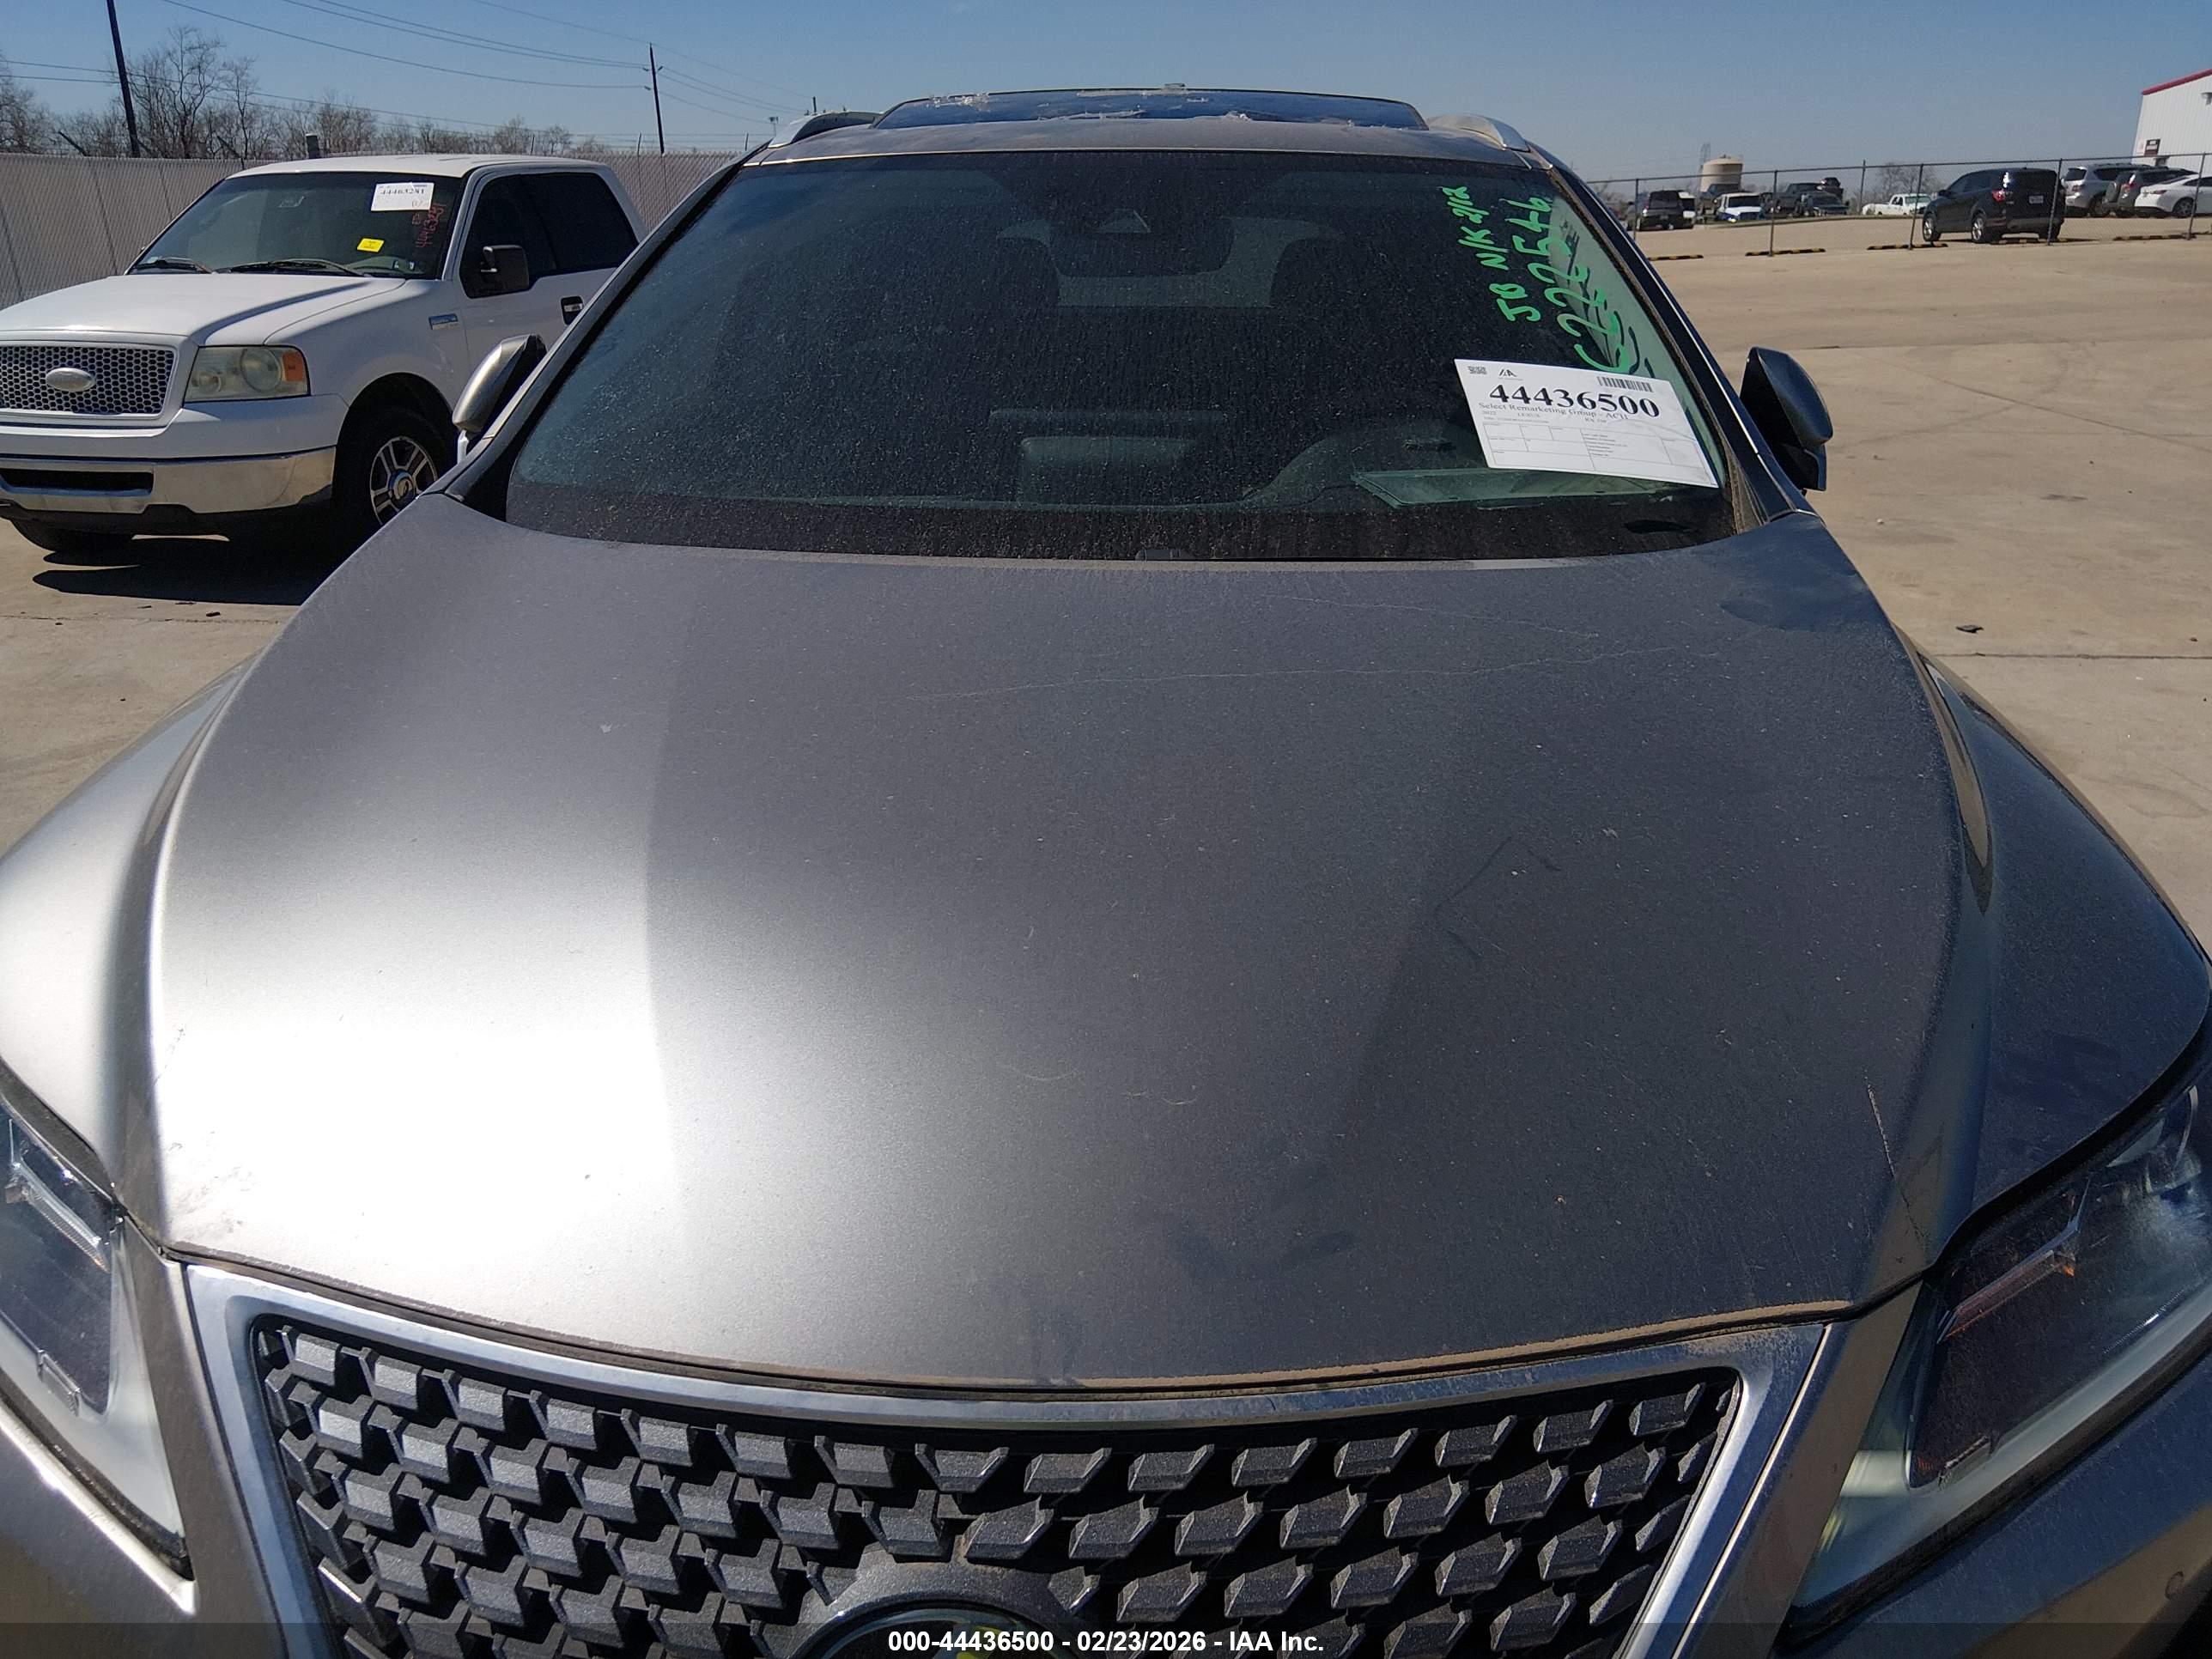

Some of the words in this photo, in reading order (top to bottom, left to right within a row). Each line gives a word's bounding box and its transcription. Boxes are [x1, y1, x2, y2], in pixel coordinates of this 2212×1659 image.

[1479, 402, 1506, 410] Select
[1509, 404, 1567, 415] Remarketing
[1569, 408, 1597, 418] Group
[1490, 384, 1660, 418] 44436500
